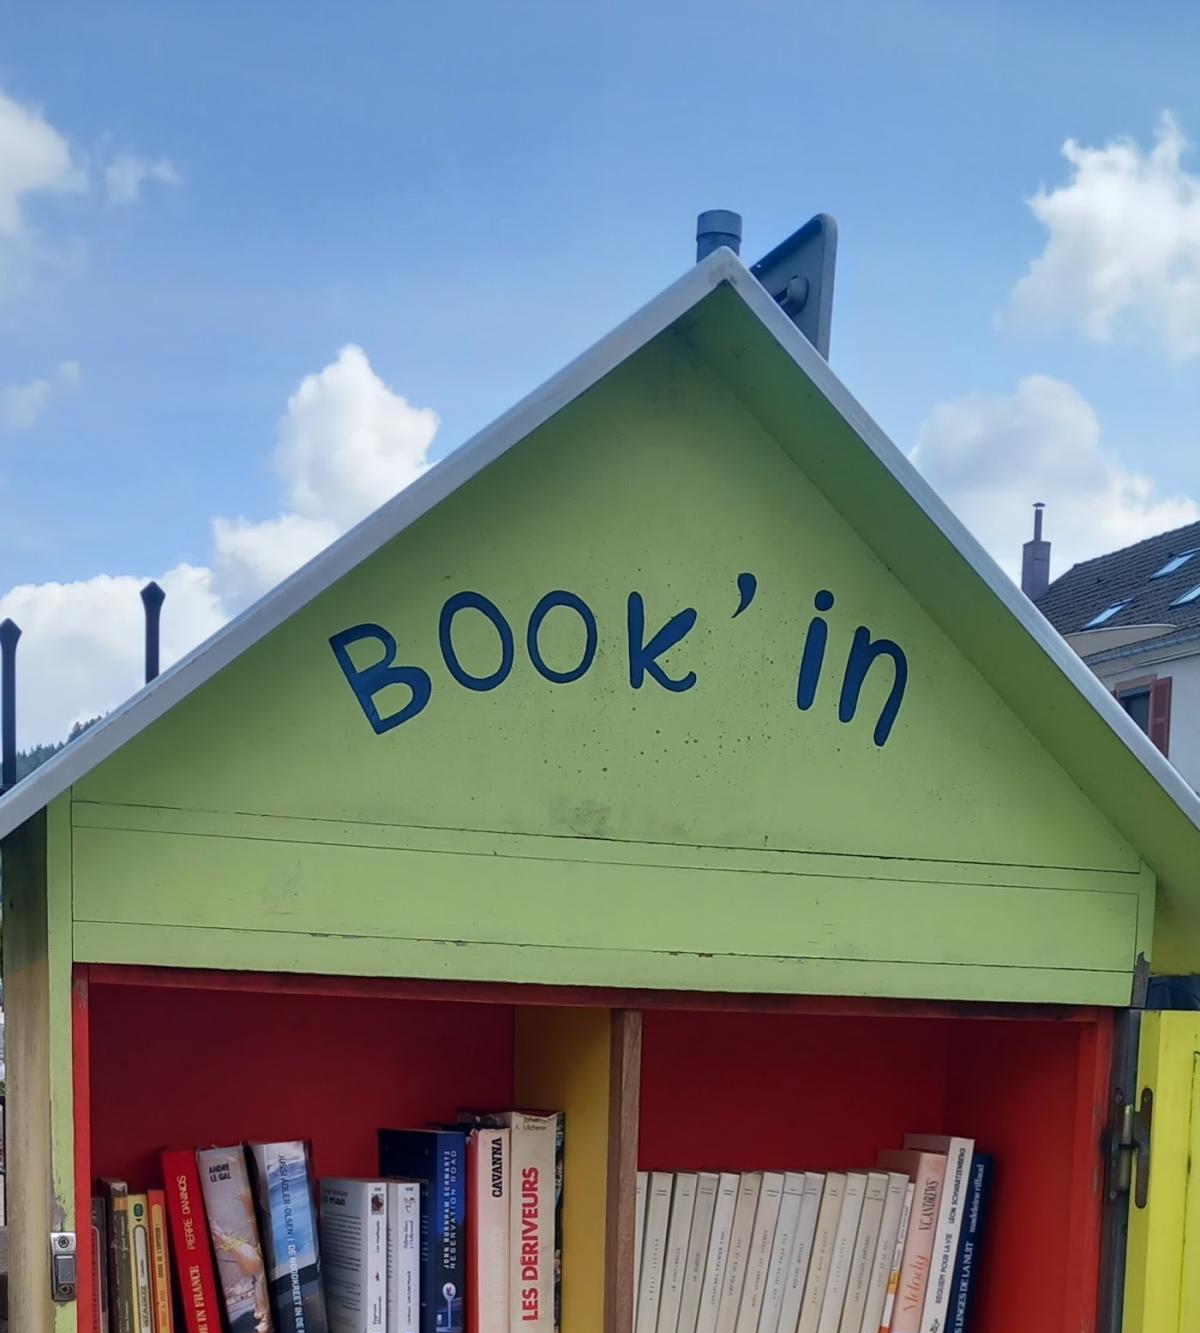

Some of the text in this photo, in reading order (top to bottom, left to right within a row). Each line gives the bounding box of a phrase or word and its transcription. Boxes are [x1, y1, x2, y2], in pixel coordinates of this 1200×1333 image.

[210, 1171, 232, 1182] LE GAL
[491, 1137, 503, 1198] CAVANNA
[176, 1175, 197, 1250] PIERRE DANINOS
[278, 1155, 293, 1236] JUSSI ADLER-OLSEN
[449, 1150, 457, 1269] RESERVATION ROAD
[948, 1207, 956, 1224] LÉON
[969, 1164, 985, 1233] madeleine riffaud
[287, 1243, 296, 1256] DE
[520, 1167, 539, 1321] LES DÉRIVEURS
[963, 1241, 974, 1265] NUIT
[188, 1265, 205, 1308] FRANCE
[288, 1256, 302, 1306] NOODKREET
[904, 1254, 929, 1312] Melody
[935, 1233, 953, 1304] REQUIEM POUR LA VIE
[959, 1279, 968, 1291] DE
[961, 1265, 970, 1278] LA
[194, 1308, 207, 1323] IN
[294, 1306, 303, 1316] IN
[295, 1317, 304, 1328] DE
[954, 1292, 966, 1329] LINGES
